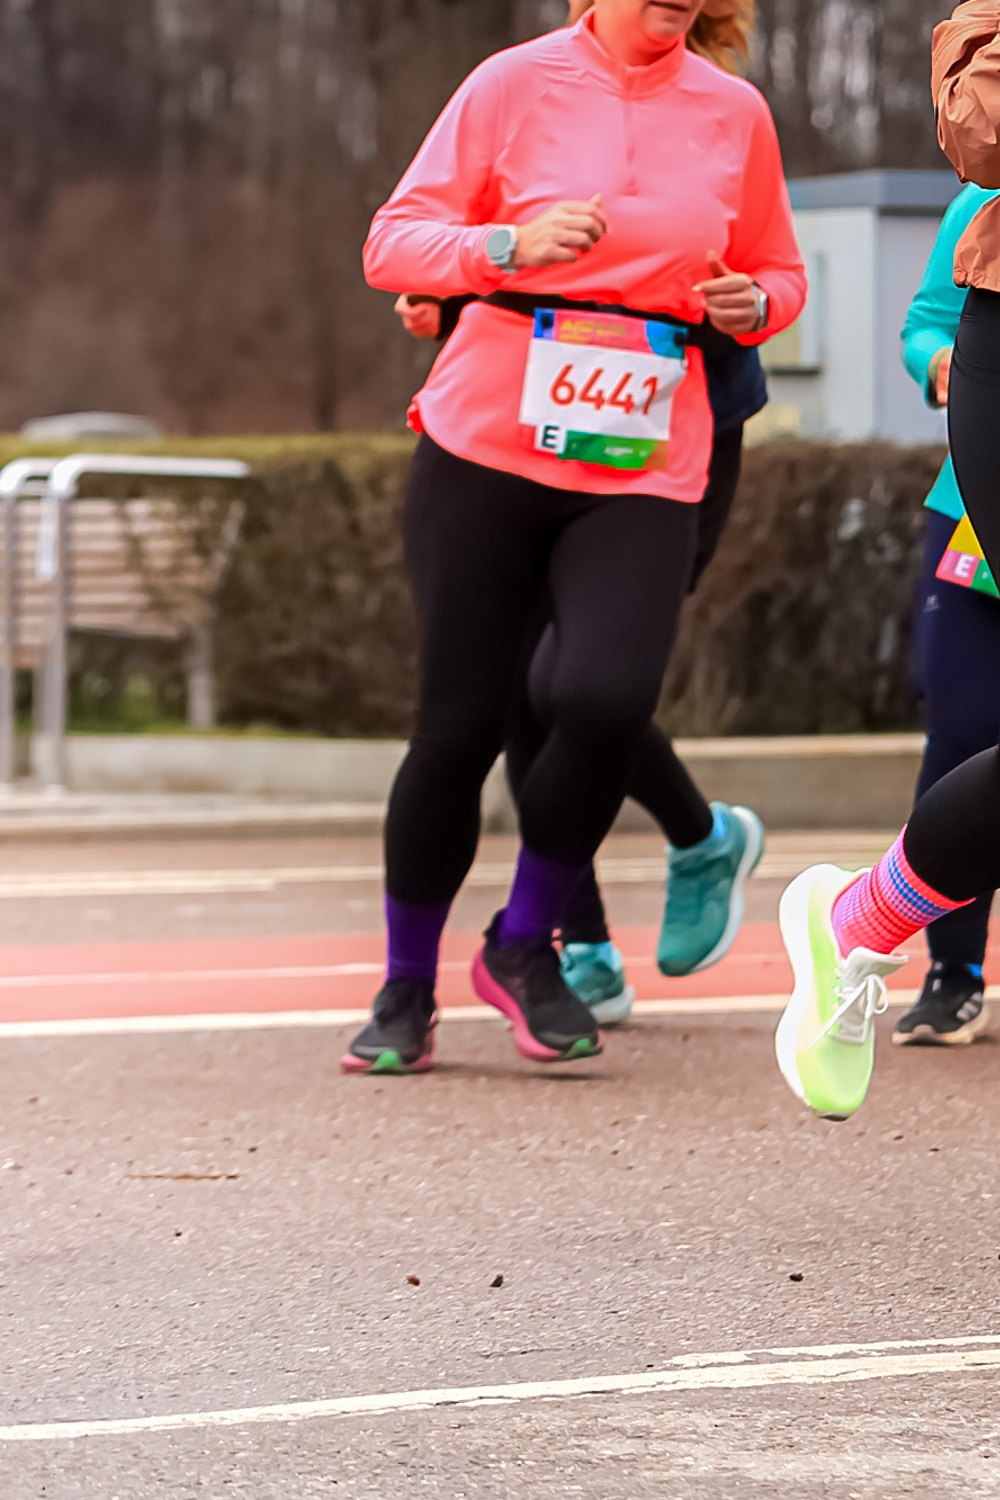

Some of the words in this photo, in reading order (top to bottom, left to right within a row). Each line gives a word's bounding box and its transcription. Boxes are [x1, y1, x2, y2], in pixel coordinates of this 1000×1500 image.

[550, 363, 659, 416] 6441
[541, 425, 560, 449] E
[954, 553, 975, 578] E
